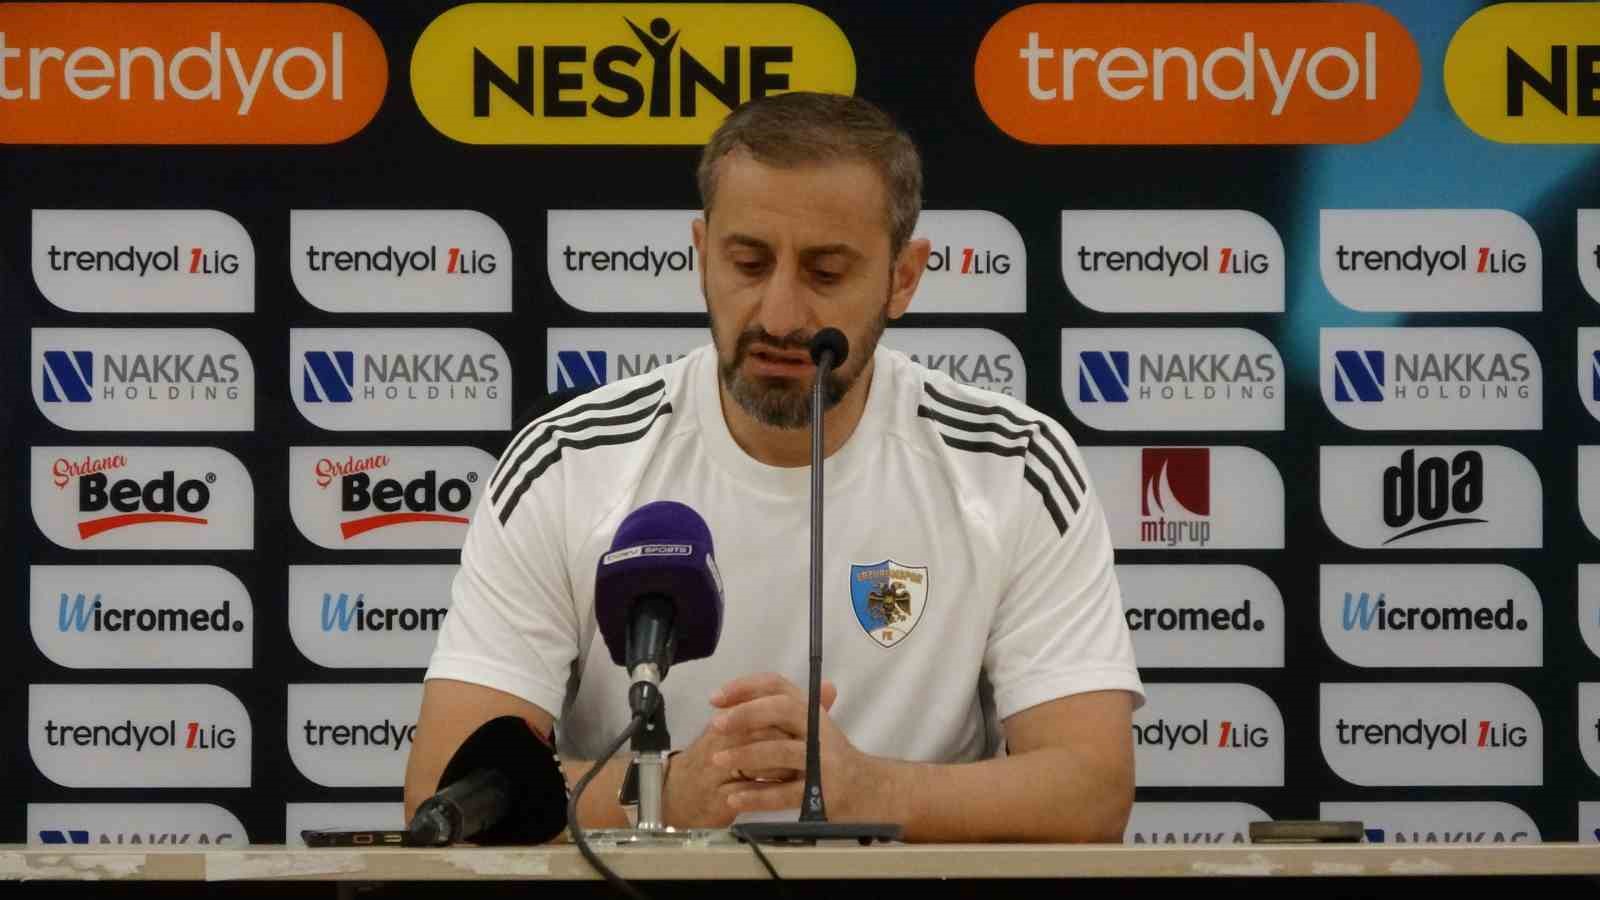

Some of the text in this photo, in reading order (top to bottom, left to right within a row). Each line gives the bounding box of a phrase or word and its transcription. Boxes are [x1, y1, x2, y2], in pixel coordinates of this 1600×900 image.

[0, 32, 342, 115] trendyol
[1020, 32, 1376, 115] trendyol
[48, 245, 179, 277] trendyol
[306, 245, 436, 277] trendyol
[563, 245, 694, 277] trendyol
[1077, 245, 1208, 277] trendyol
[1336, 245, 1466, 277] trendyol
[1383, 448, 1484, 528] doa
[1141, 519, 1210, 547] mtgrup
[321, 592, 448, 631] Wicrom
[1124, 599, 1265, 632] cromed.
[44, 720, 175, 752] trendyol
[303, 719, 416, 751] trendy
[1132, 719, 1208, 751] ndyol
[1336, 718, 1467, 751] trendyol
